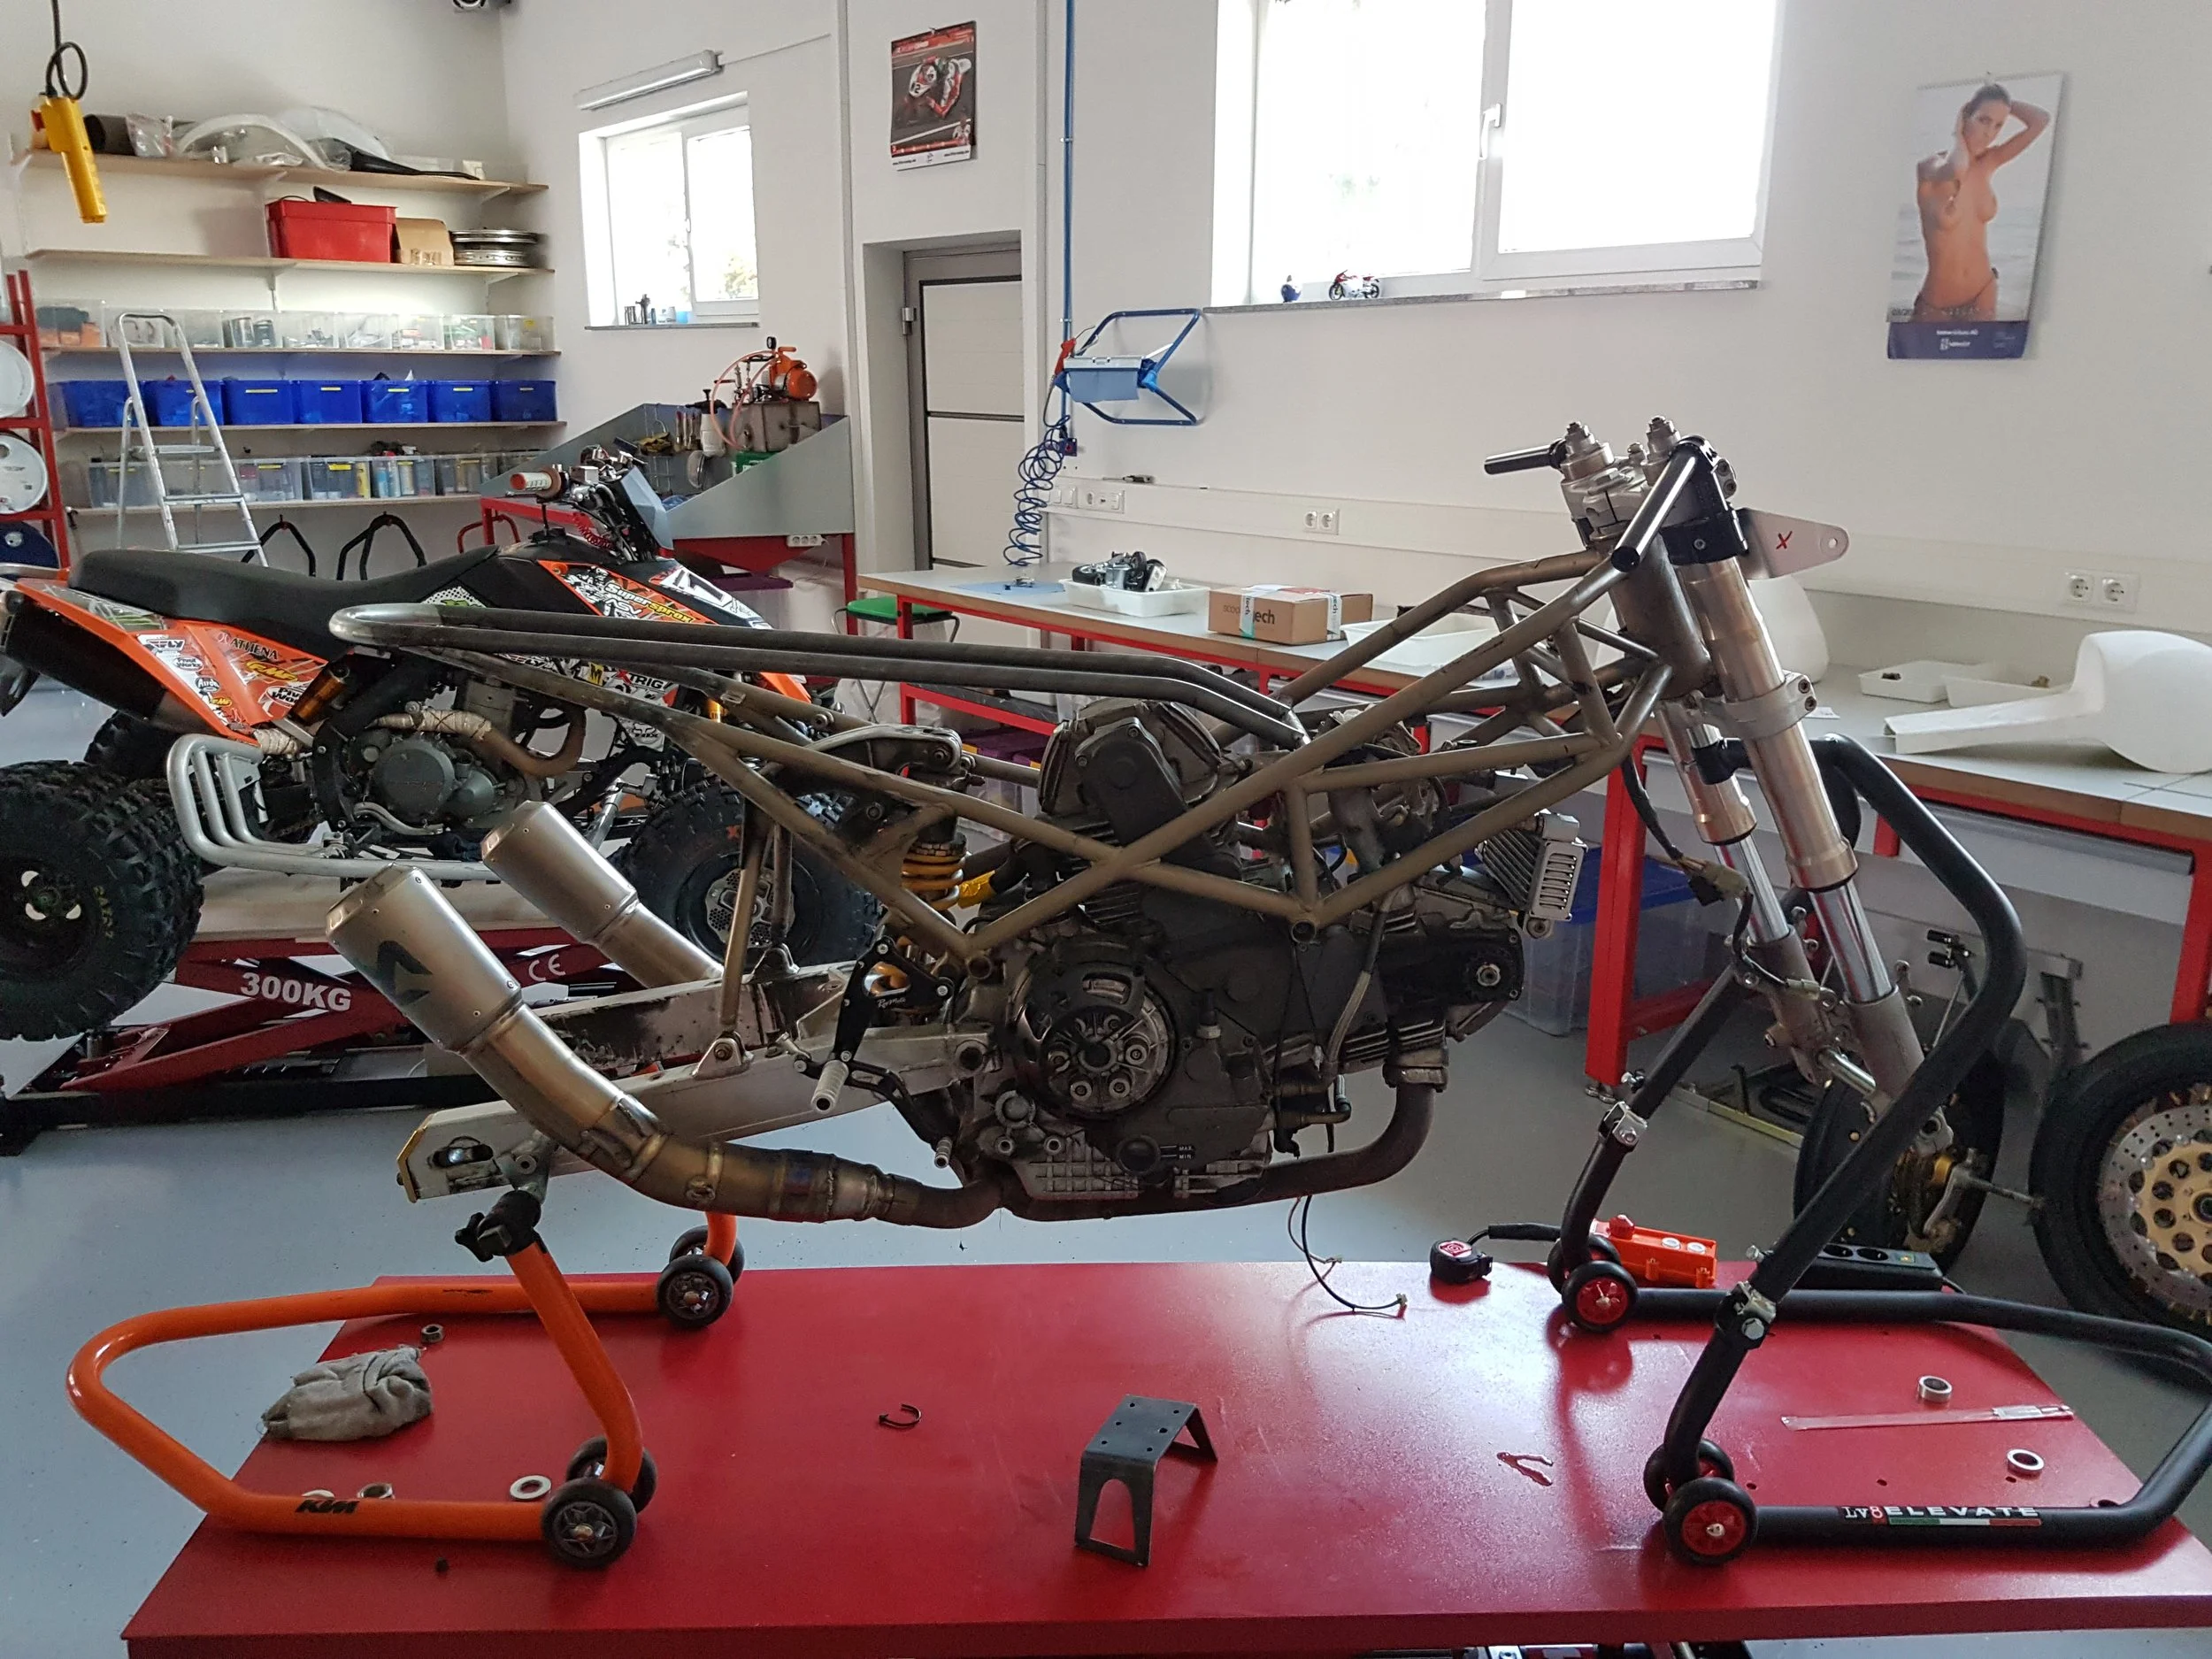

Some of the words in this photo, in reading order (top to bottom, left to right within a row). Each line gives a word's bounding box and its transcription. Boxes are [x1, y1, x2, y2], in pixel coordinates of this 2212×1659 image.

[604, 582, 694, 623] Supersprox
[231, 638, 278, 660] ATHENA
[247, 662, 297, 682] FMF
[528, 953, 566, 982] CE
[240, 972, 351, 1011] 300KG
[295, 1499, 360, 1514] KTM
[1884, 1506, 2039, 1517] ELEVATE
